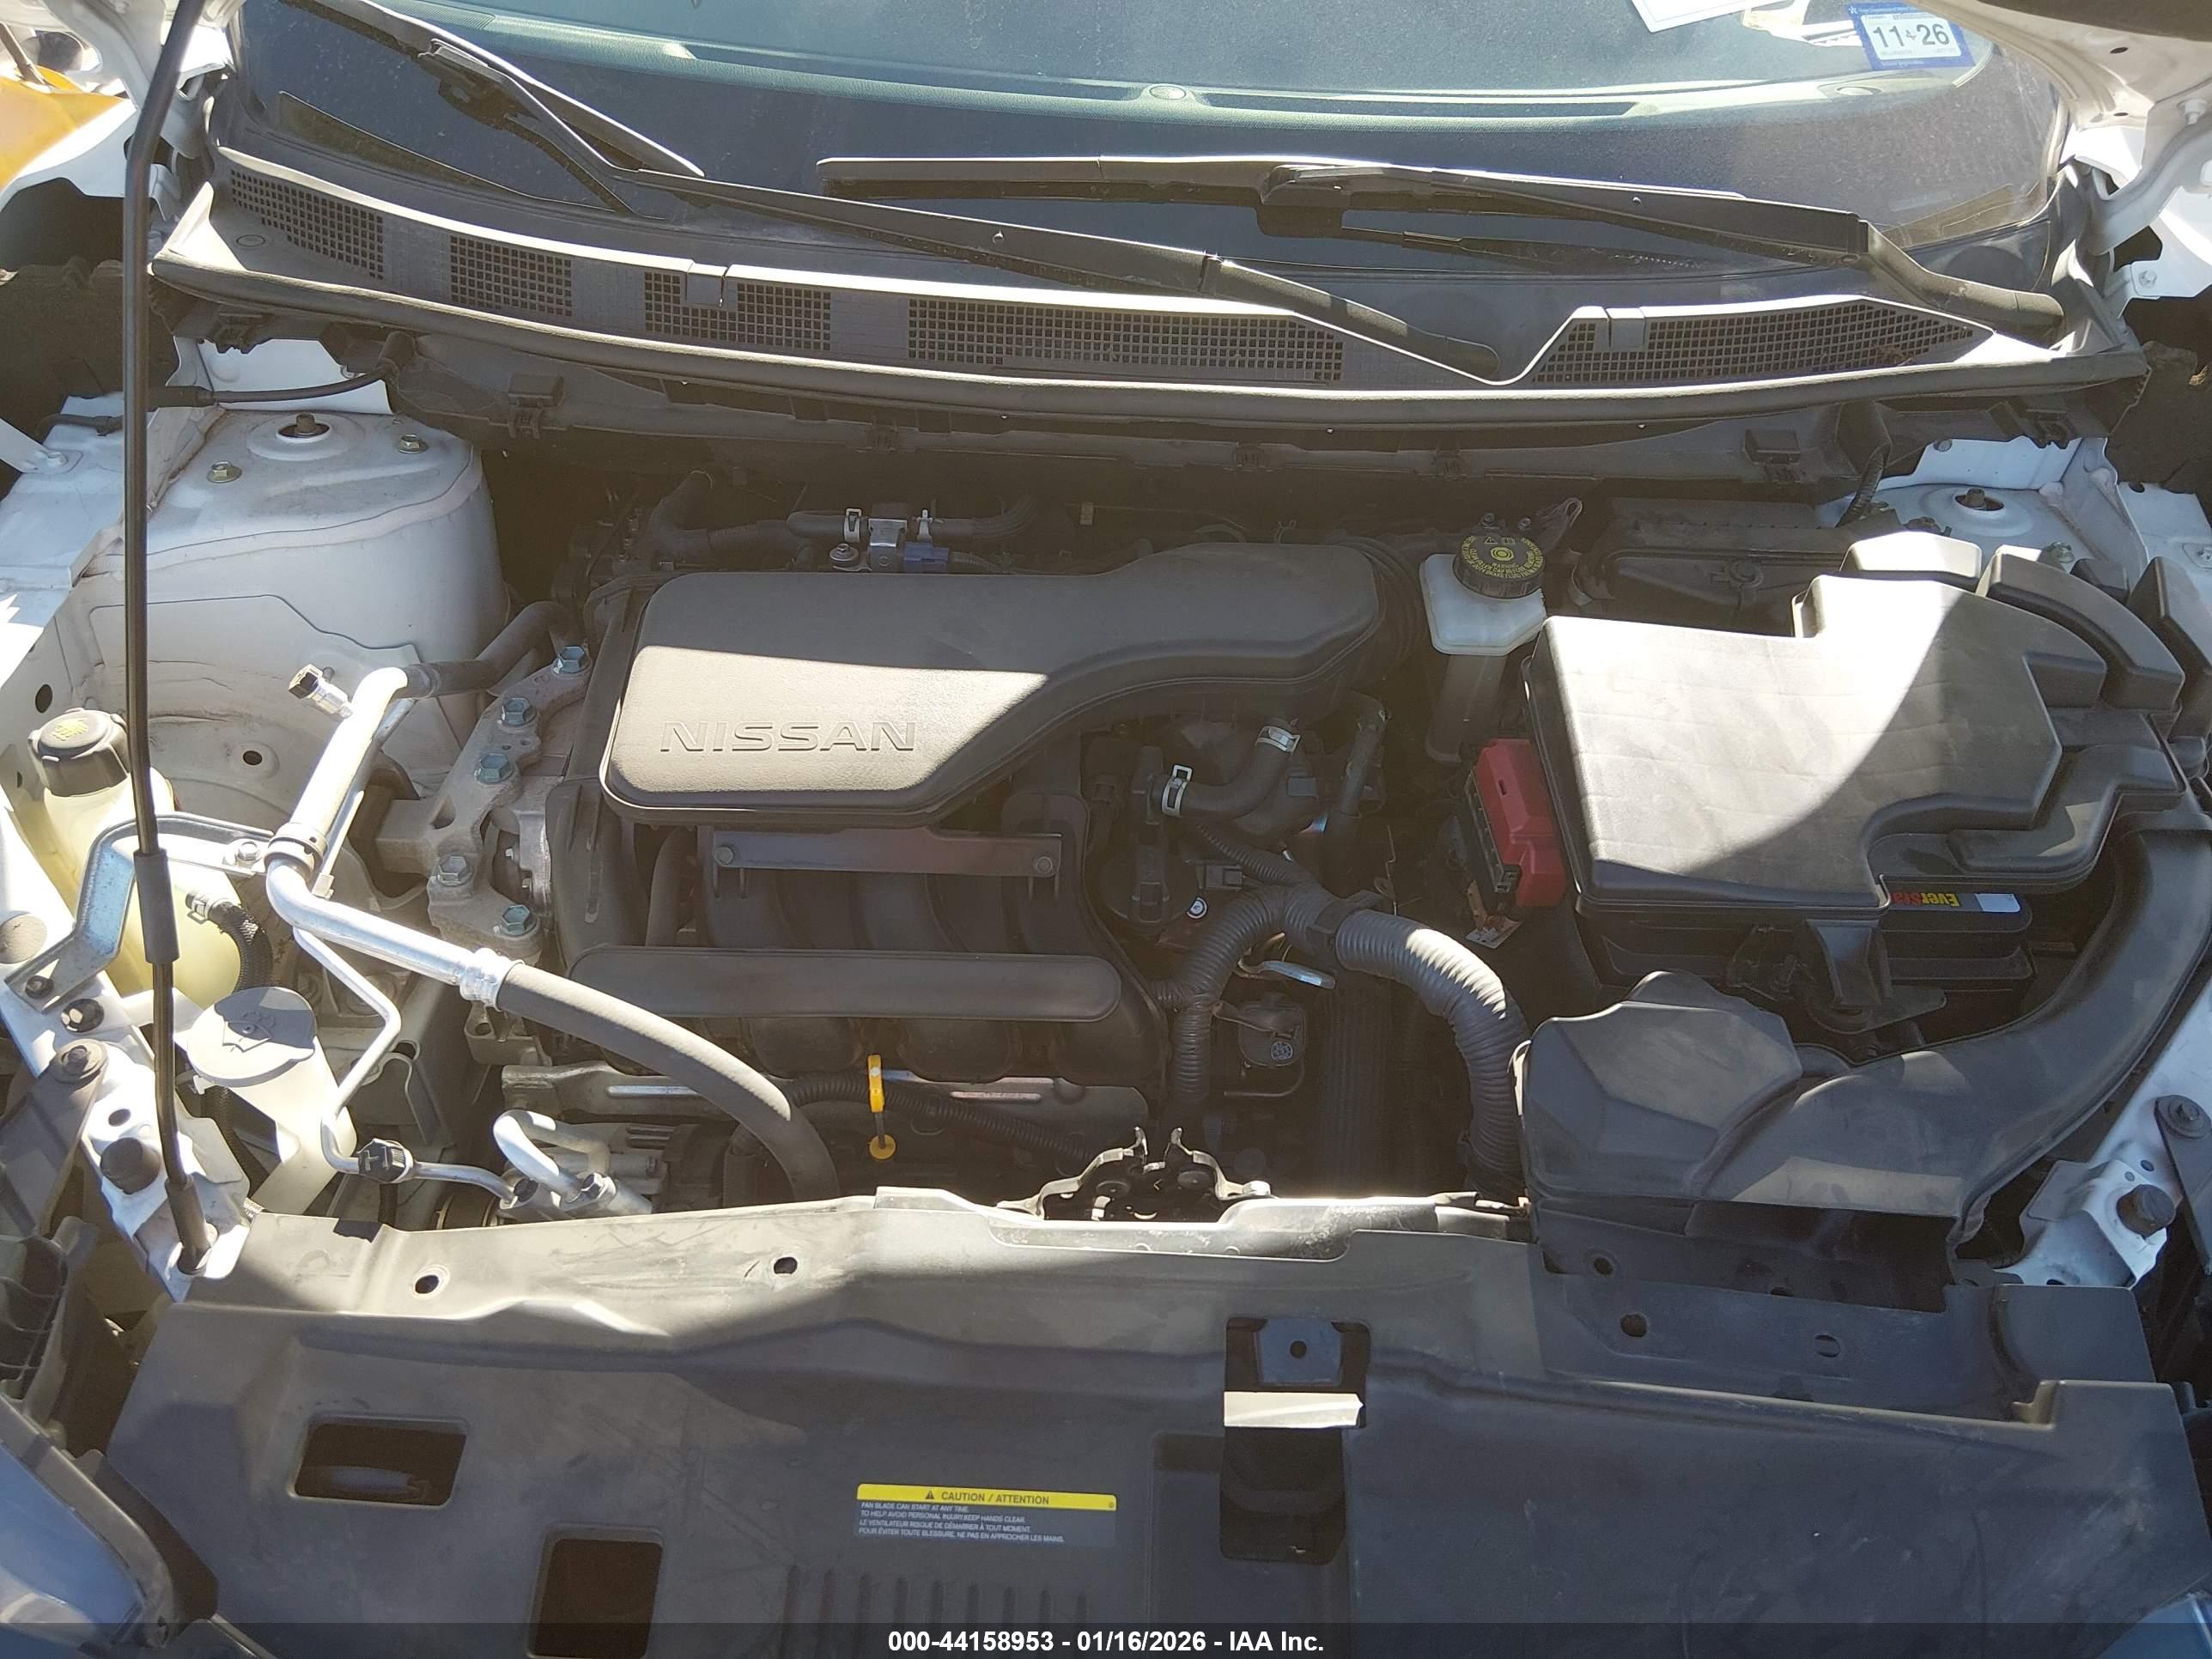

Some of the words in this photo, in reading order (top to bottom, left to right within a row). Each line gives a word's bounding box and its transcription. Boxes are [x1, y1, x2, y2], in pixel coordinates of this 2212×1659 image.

[1873, 26, 1905, 48] 11
[1916, 23, 1950, 46] 26
[660, 721, 916, 752] NISSAN
[941, 1492, 985, 1502] CAUTION
[996, 1494, 1049, 1504] ATTENTION
[908, 1511, 941, 1520] PERSONAL
